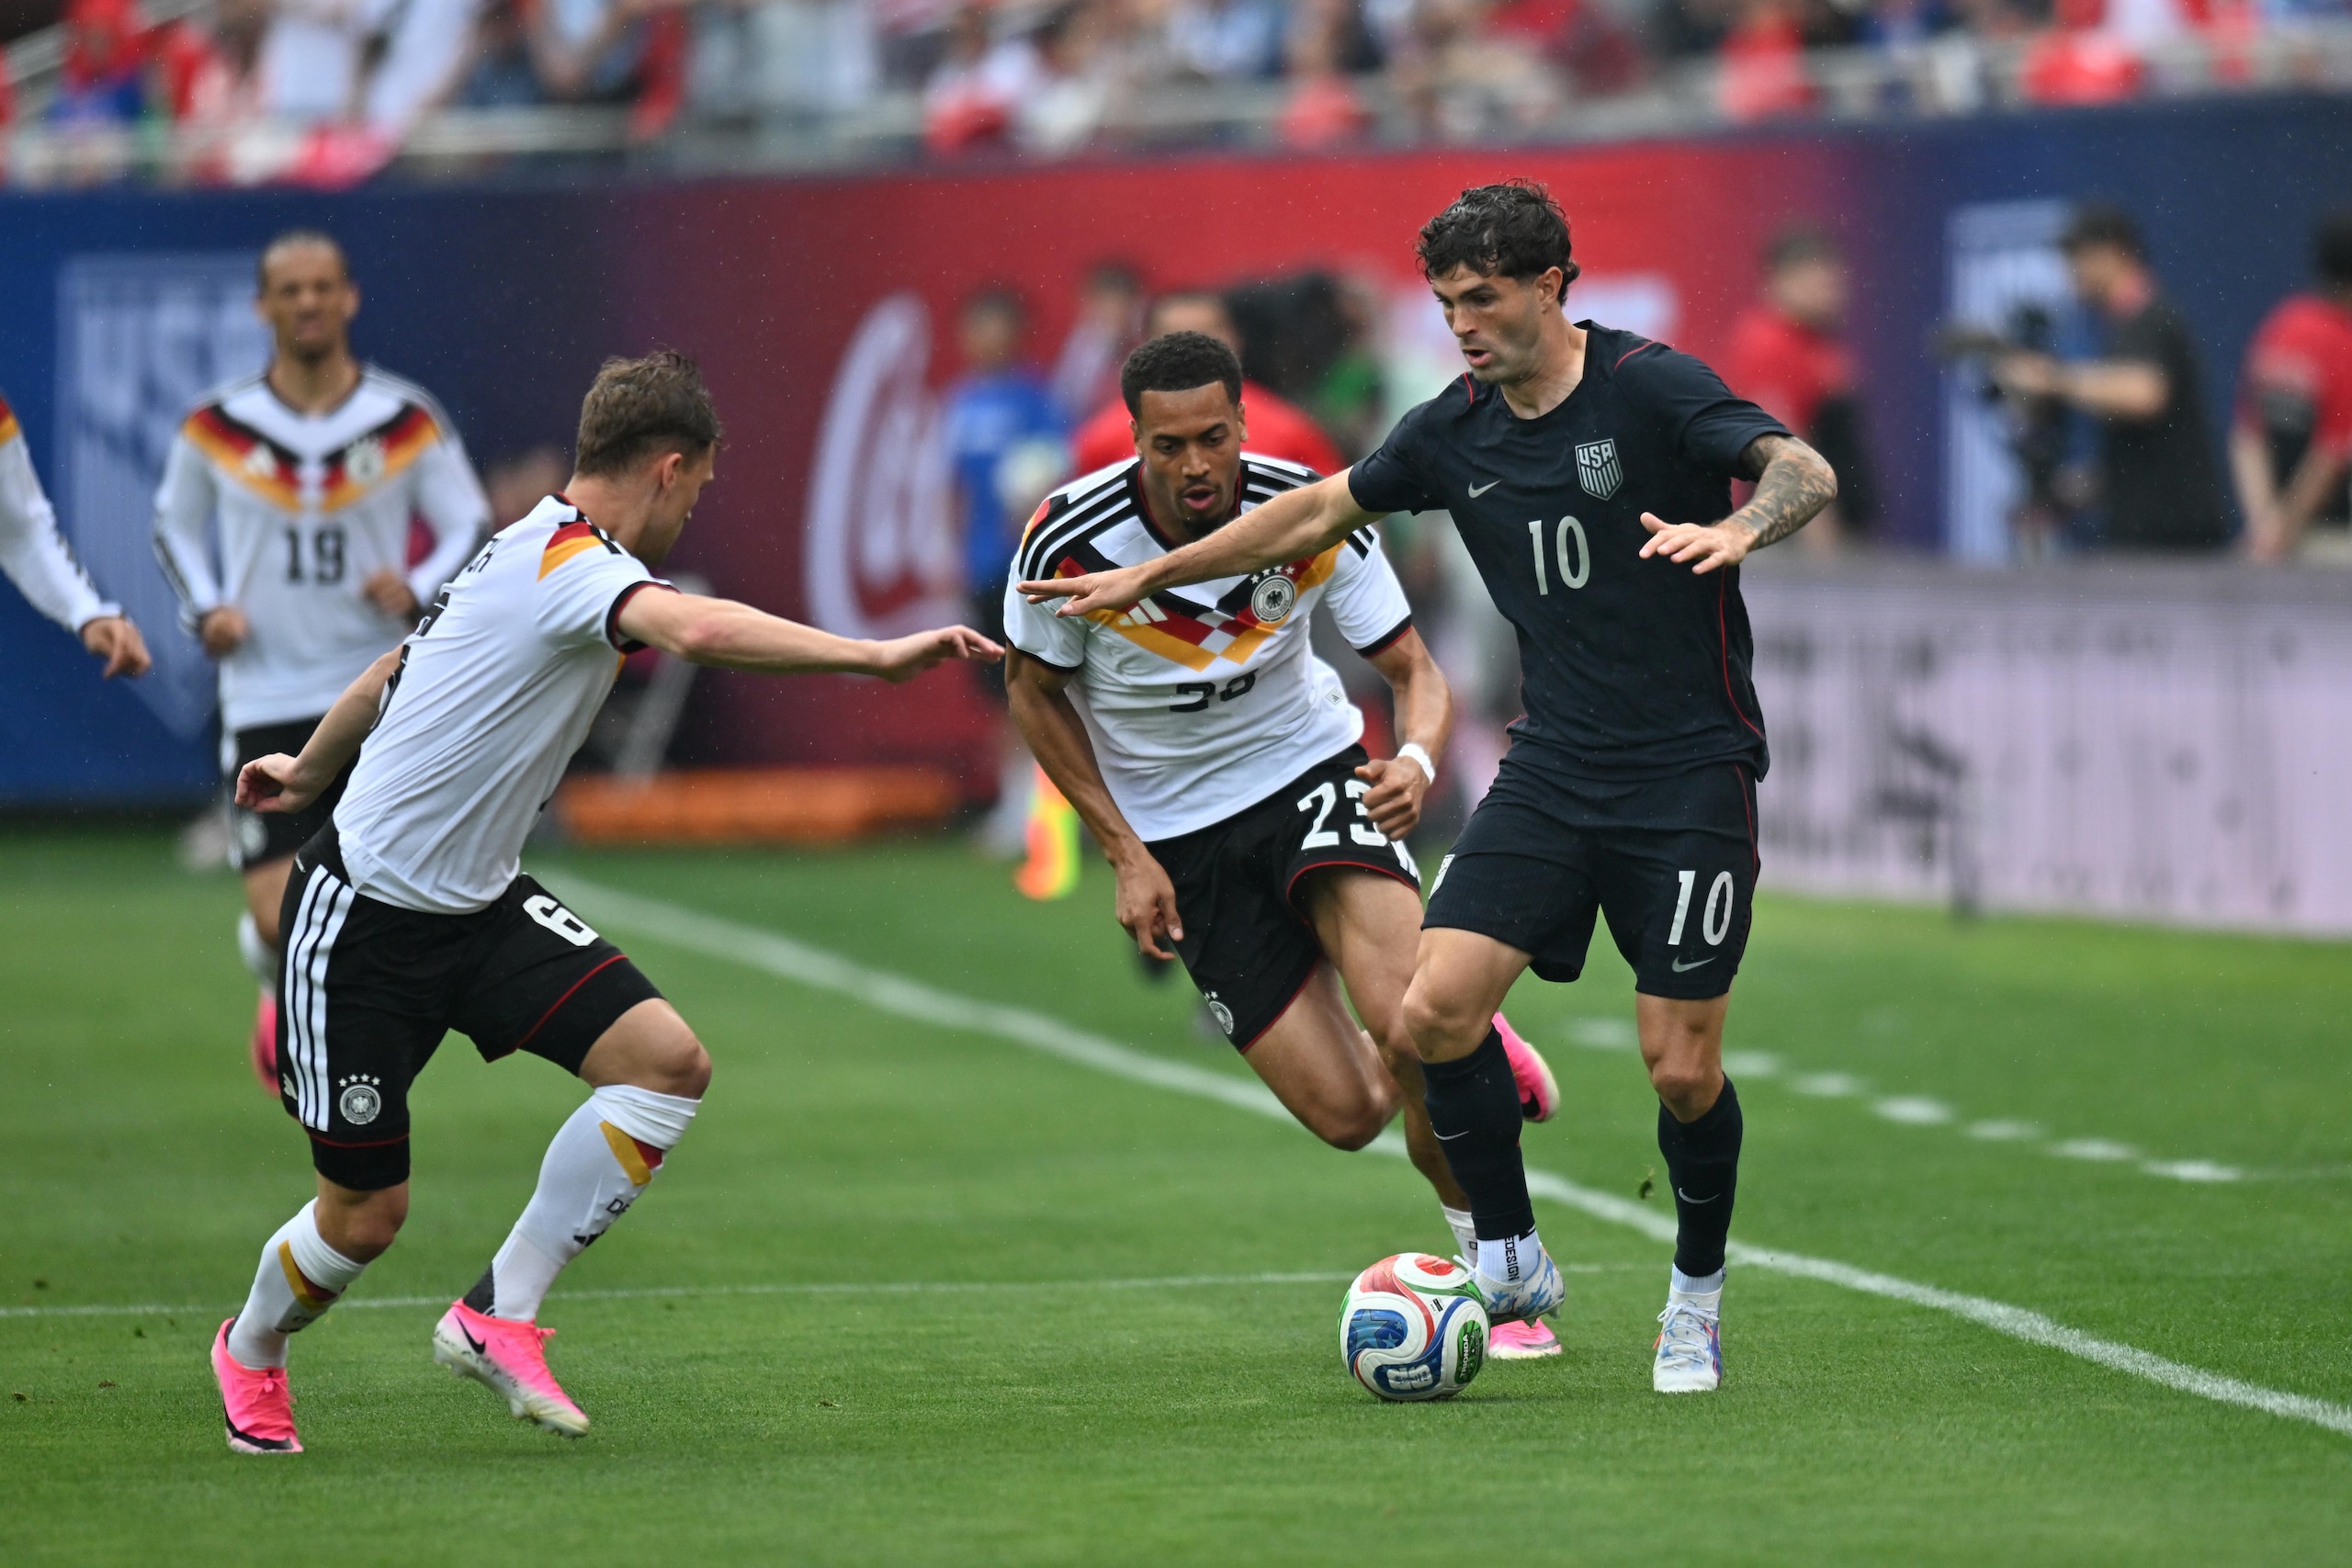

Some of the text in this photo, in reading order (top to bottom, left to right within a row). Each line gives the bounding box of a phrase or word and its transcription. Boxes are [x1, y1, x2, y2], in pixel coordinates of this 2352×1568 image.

[1577, 443, 1613, 468] USA
[284, 526, 346, 586] 19
[1528, 515, 1590, 596] 10
[1296, 779, 1388, 851] 23
[522, 894, 600, 947] 6
[1668, 870, 1734, 946] 10
[1460, 1334, 1468, 1378] TRIONDA
